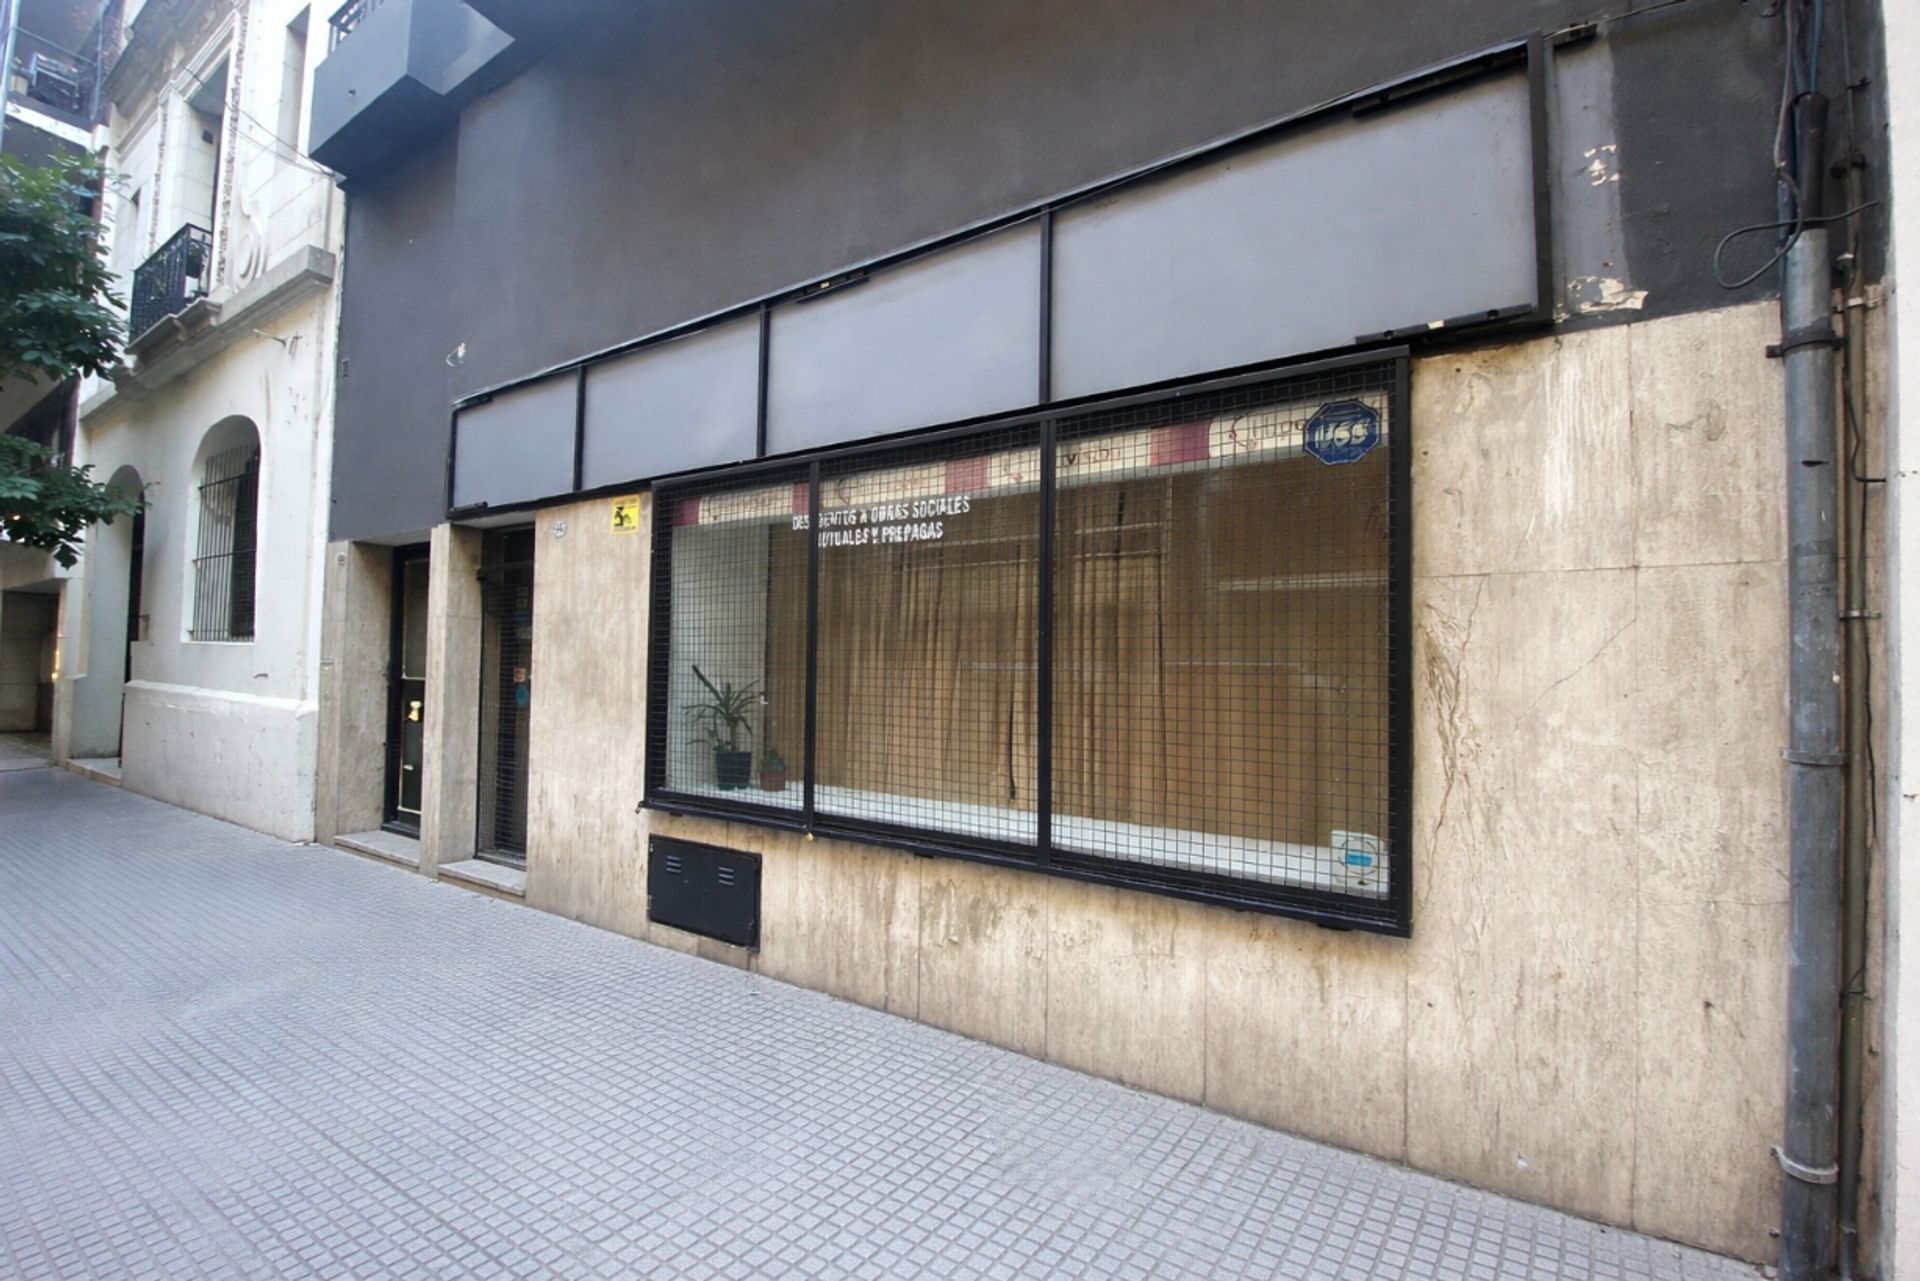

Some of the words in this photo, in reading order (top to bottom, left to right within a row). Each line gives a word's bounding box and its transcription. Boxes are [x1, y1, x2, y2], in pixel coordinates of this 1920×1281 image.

[871, 504, 909, 524] OBRAS
[912, 496, 971, 519] SOCIALES
[818, 527, 869, 548] UTUALES
[872, 527, 879, 544] Y
[882, 522, 943, 544] PREPAGAS
